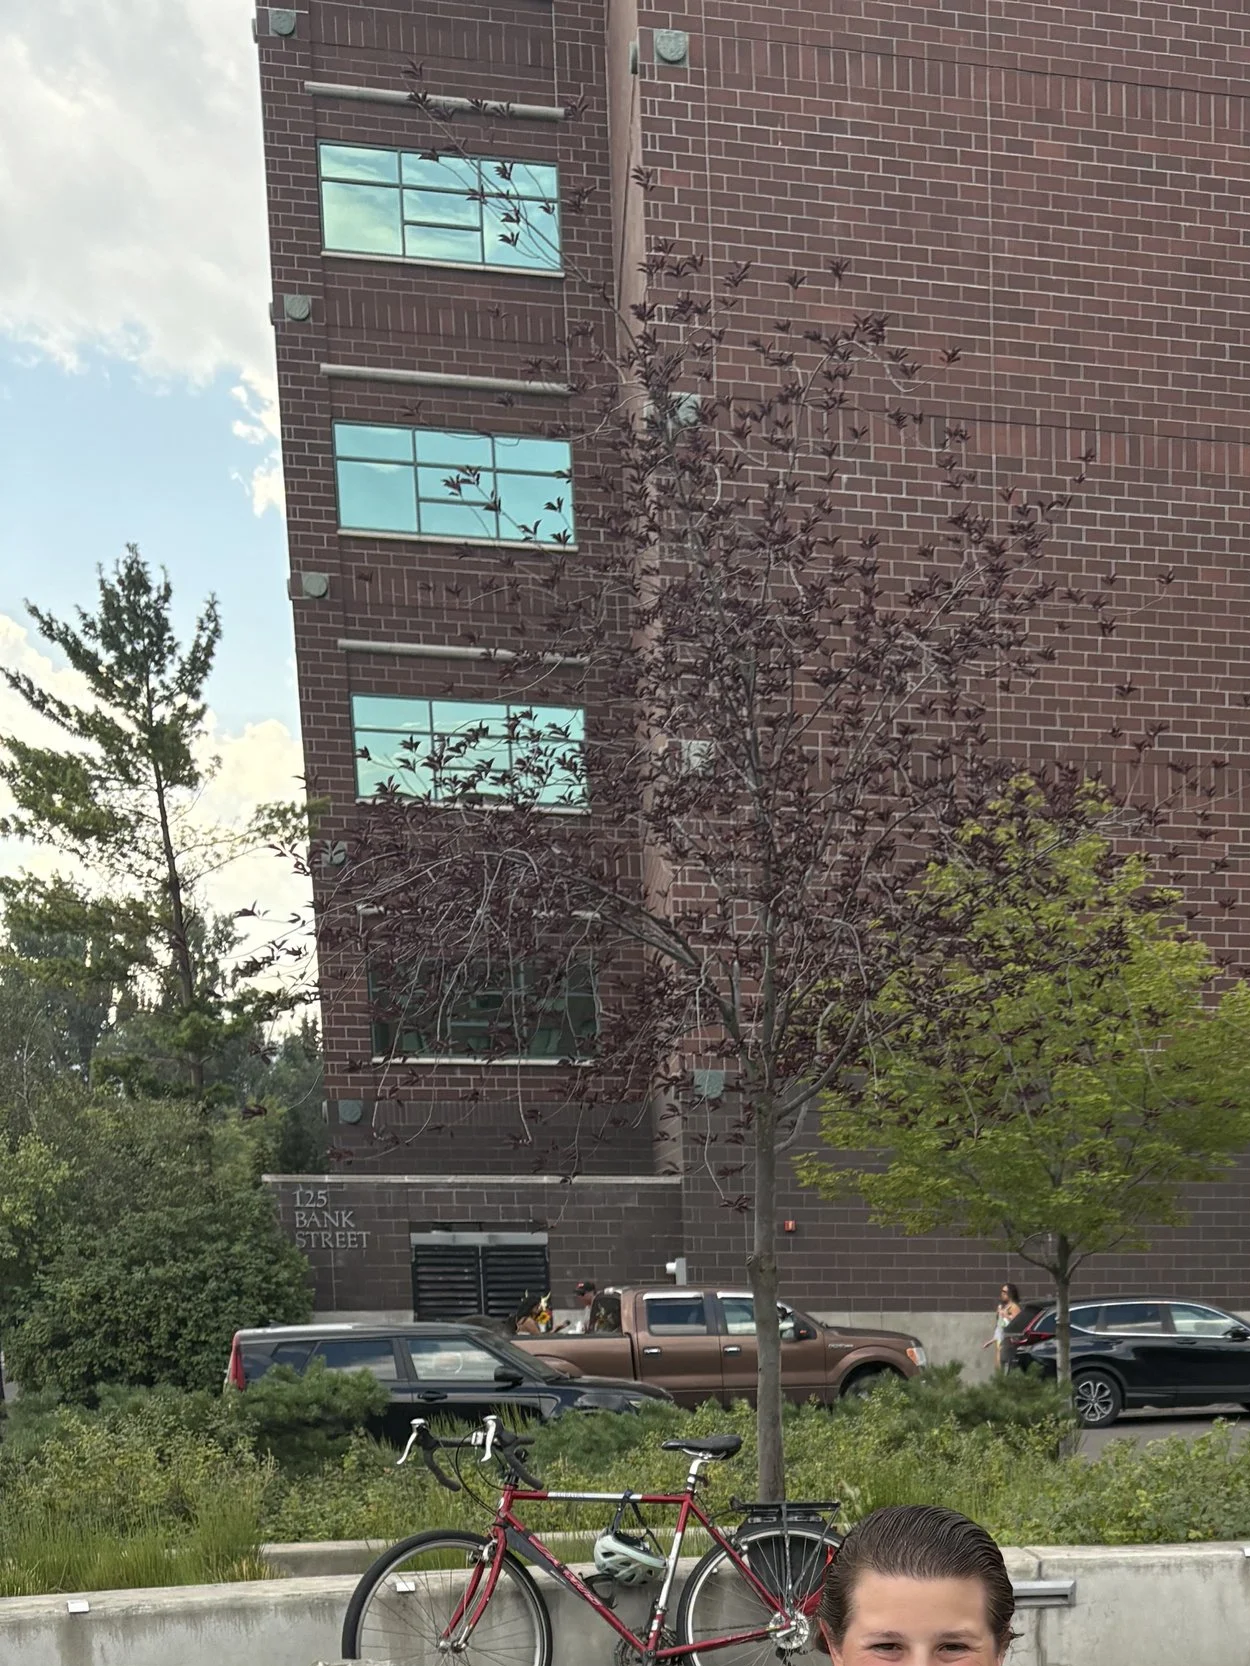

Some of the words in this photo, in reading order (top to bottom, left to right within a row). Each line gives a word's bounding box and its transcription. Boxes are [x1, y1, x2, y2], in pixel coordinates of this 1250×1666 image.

[292, 1190, 328, 1208] 125
[294, 1210, 356, 1228] BANK
[295, 1231, 371, 1249] STREET
